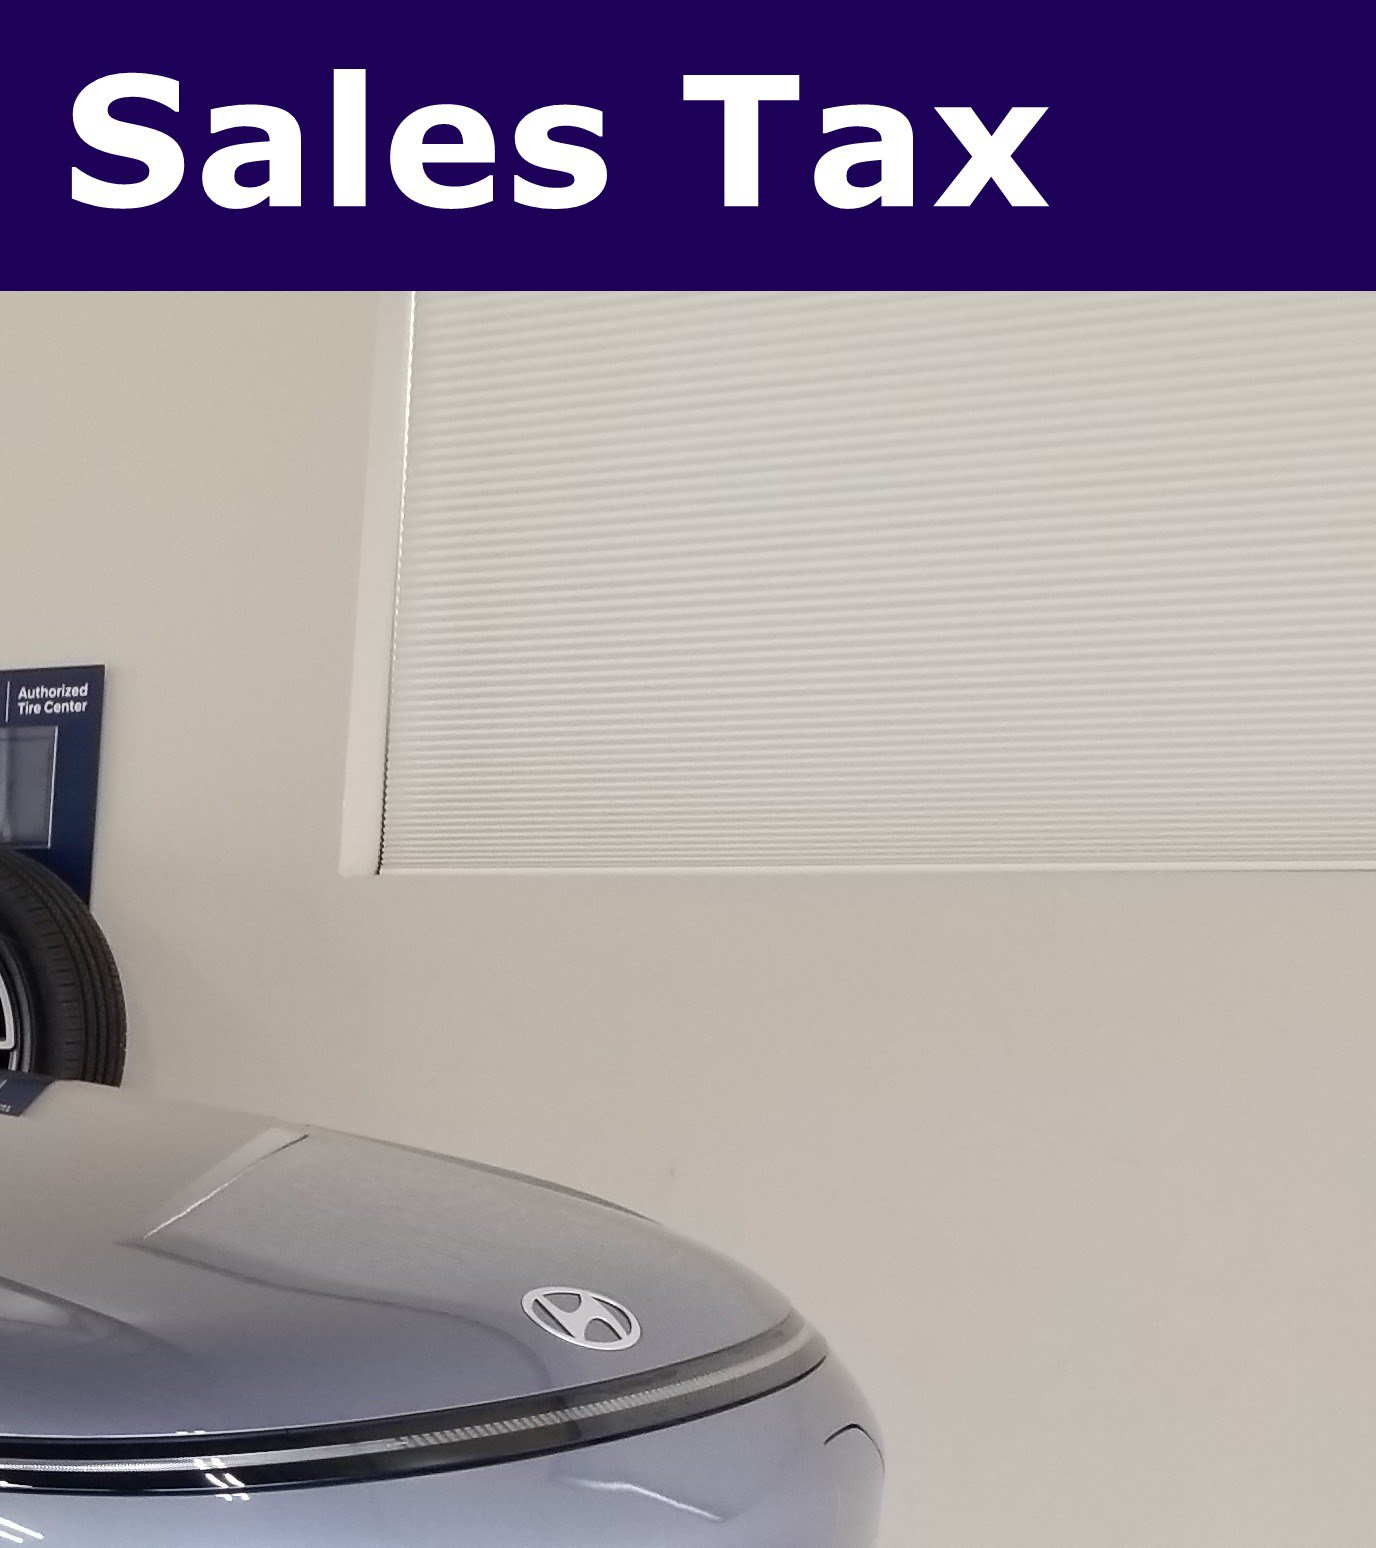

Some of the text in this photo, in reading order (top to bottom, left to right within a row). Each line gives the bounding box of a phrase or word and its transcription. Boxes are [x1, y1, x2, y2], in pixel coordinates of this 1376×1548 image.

[17, 682, 89, 700] Authorized
[17, 700, 88, 716] Tire Center
